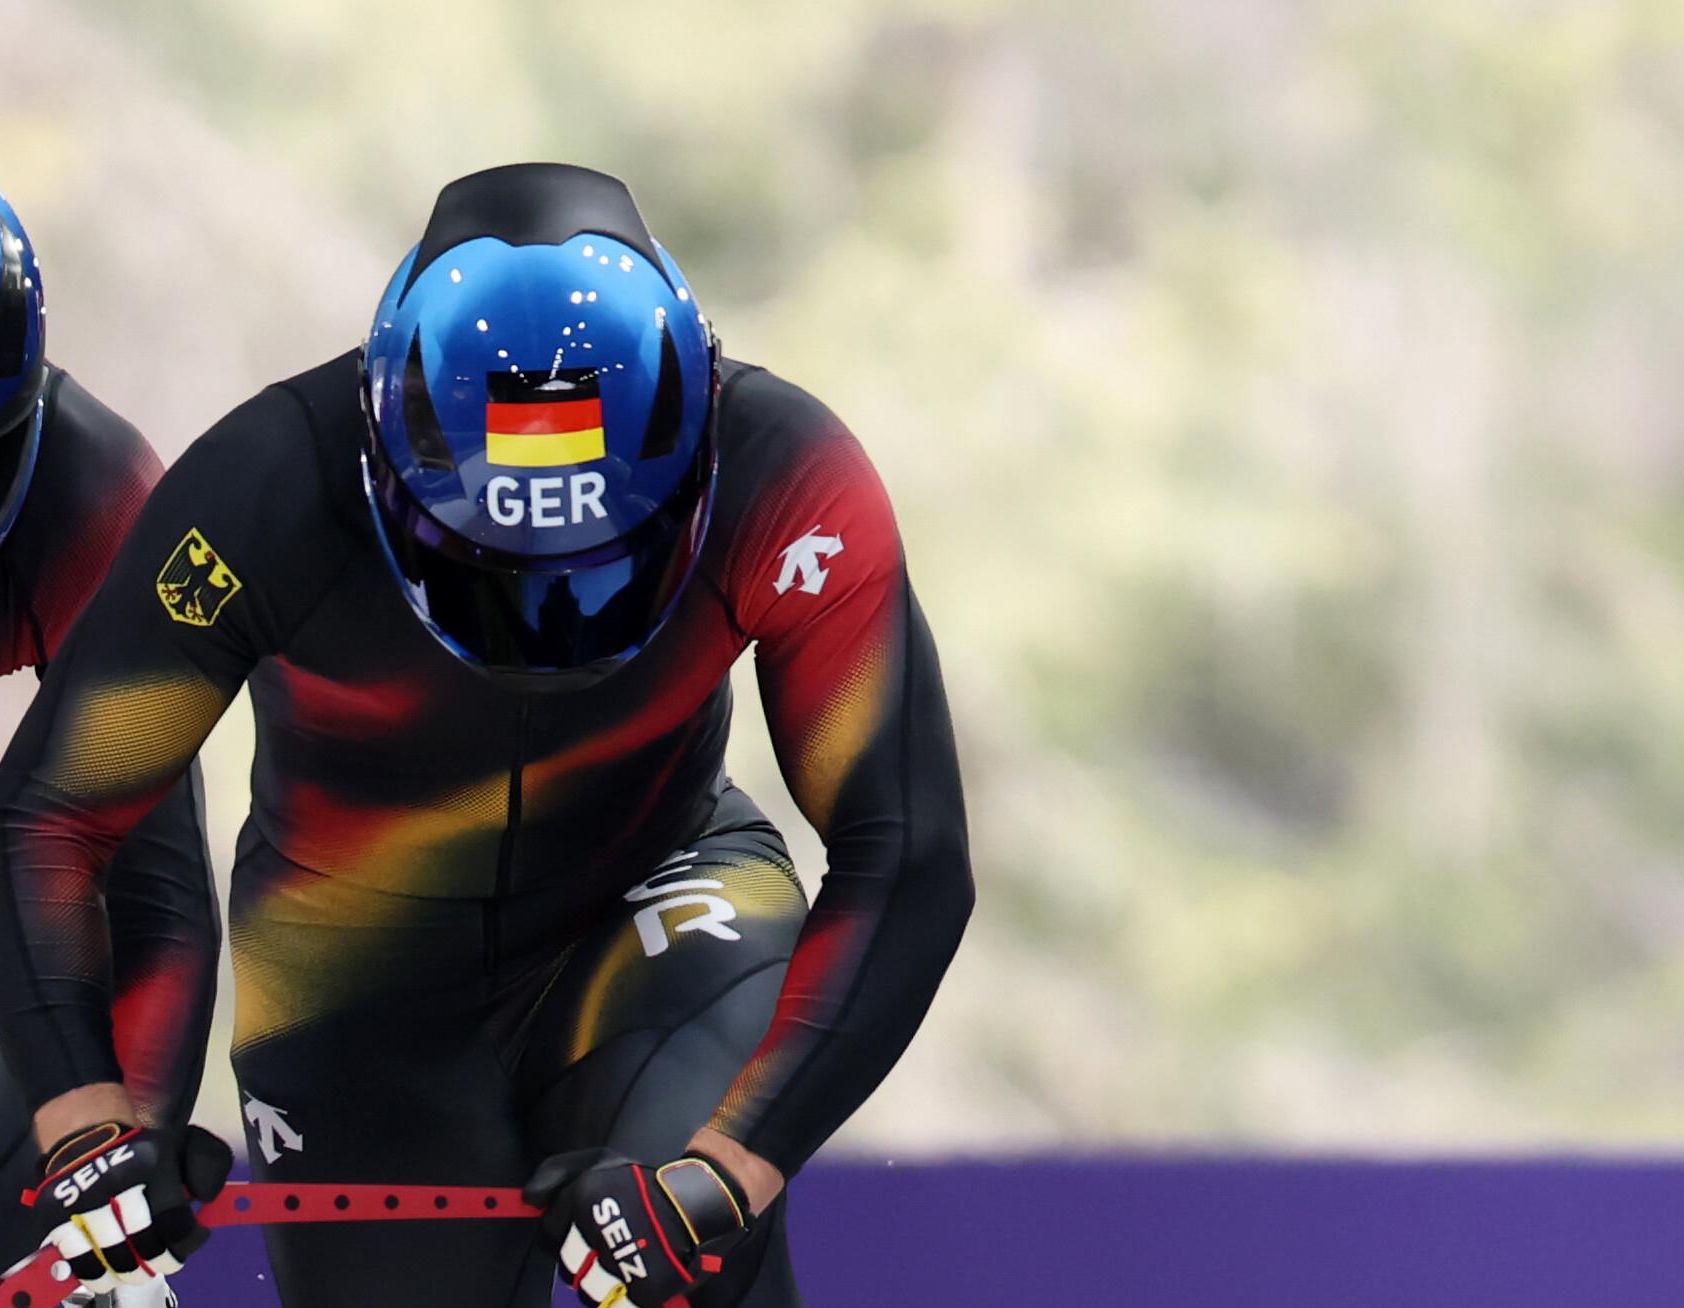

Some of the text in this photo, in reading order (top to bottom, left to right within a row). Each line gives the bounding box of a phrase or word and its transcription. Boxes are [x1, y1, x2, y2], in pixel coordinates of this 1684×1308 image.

[486, 471, 608, 527] GER
[623, 850, 741, 957] ER
[53, 1143, 135, 1208] SEIZ
